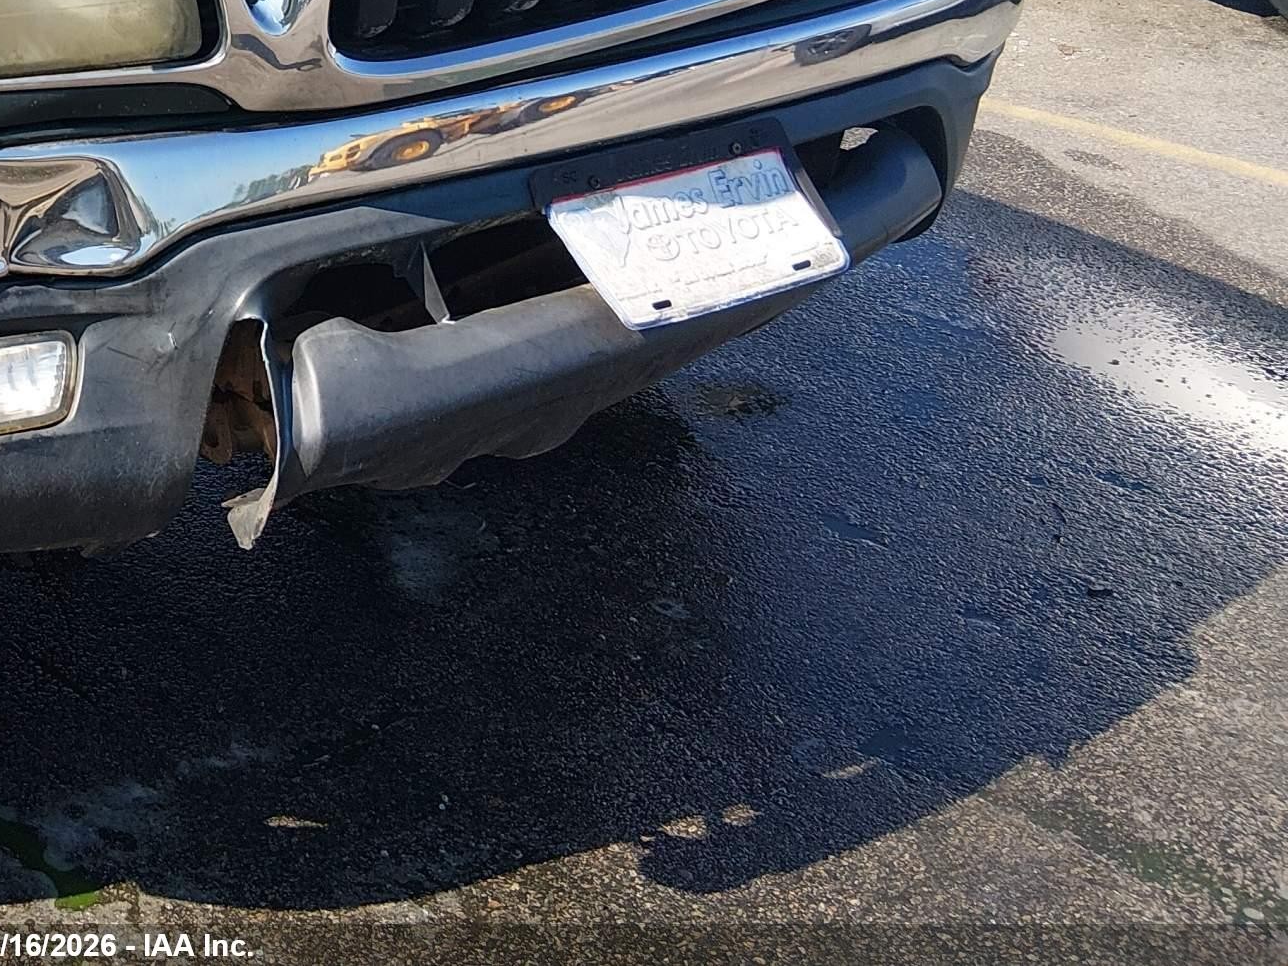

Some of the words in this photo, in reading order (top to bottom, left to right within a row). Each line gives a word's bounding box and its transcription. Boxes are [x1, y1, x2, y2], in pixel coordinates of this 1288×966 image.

[610, 186, 709, 235] James
[707, 158, 792, 209] Ervin
[681, 208, 801, 254] TOYOTA
